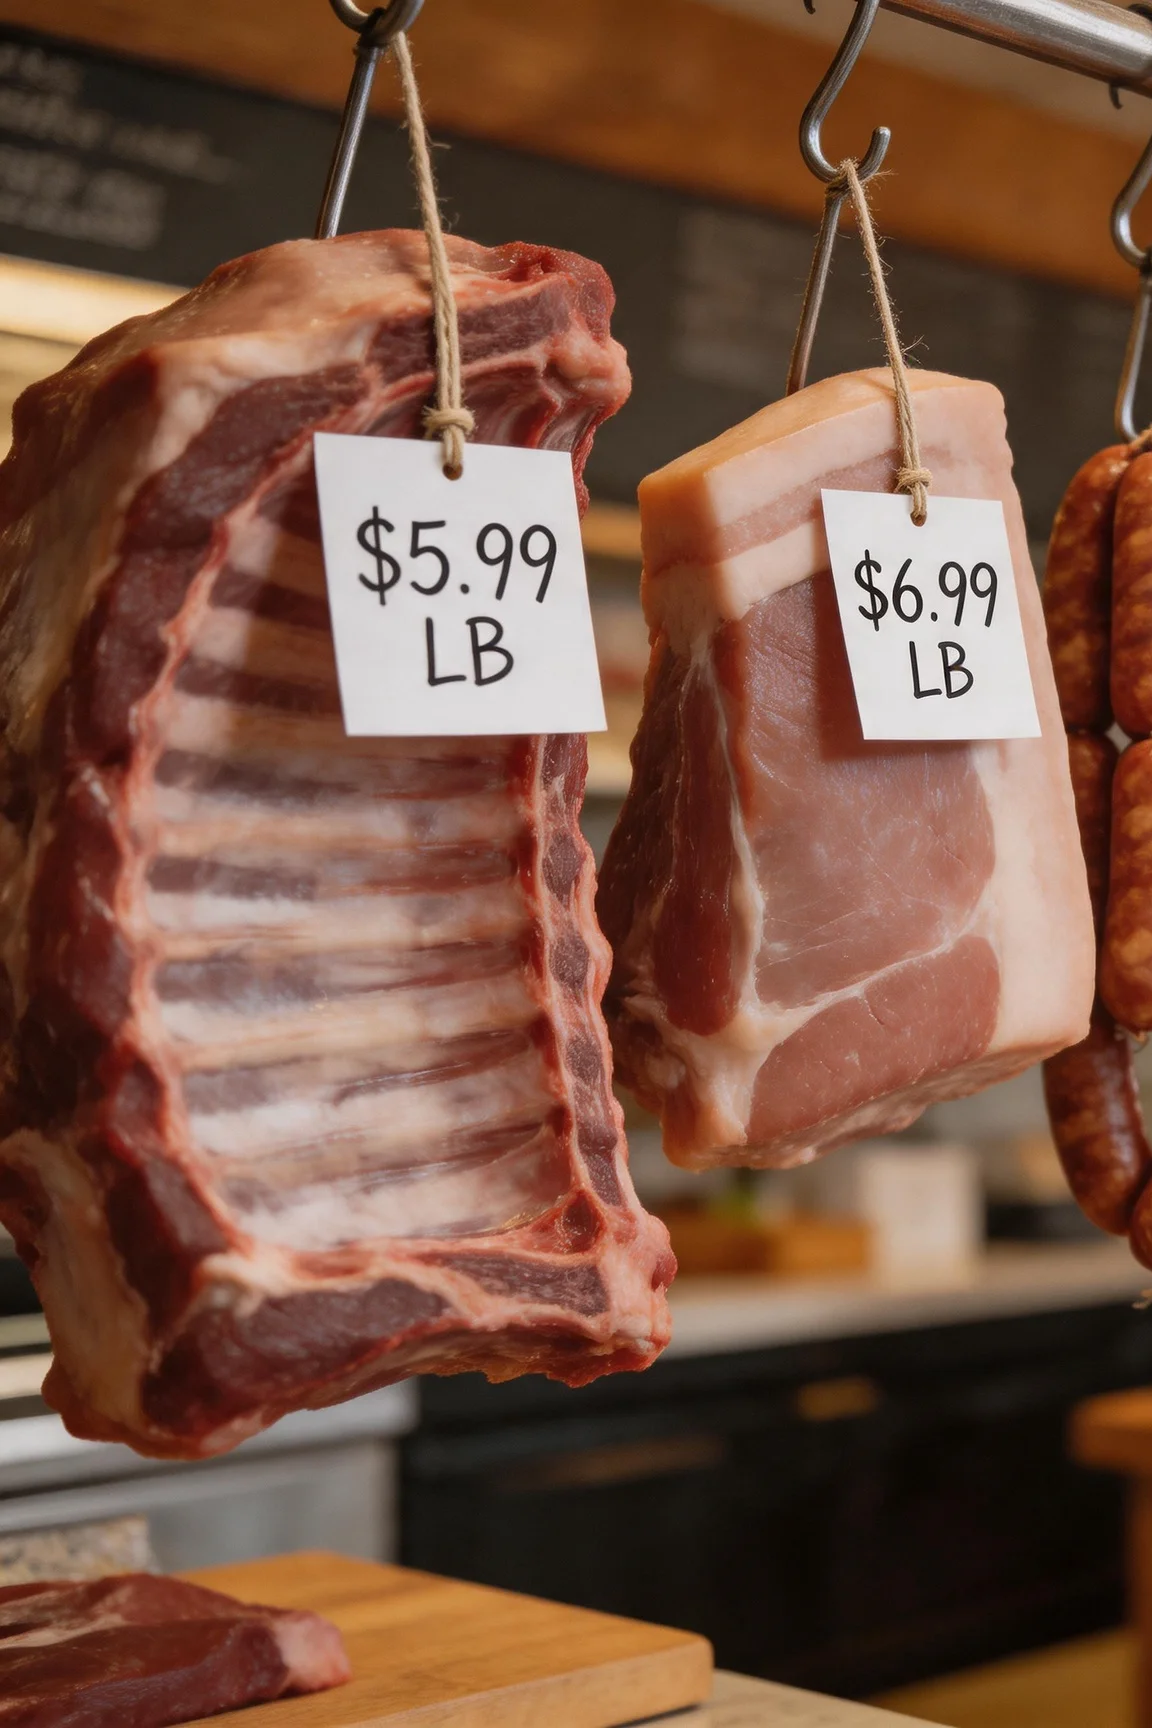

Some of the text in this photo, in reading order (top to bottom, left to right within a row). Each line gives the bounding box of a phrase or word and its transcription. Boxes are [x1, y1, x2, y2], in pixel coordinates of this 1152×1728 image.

[356, 505, 558, 606] $5.99
[854, 548, 998, 632] $6.99
[425, 616, 514, 687] LB
[908, 638, 974, 700] LB
